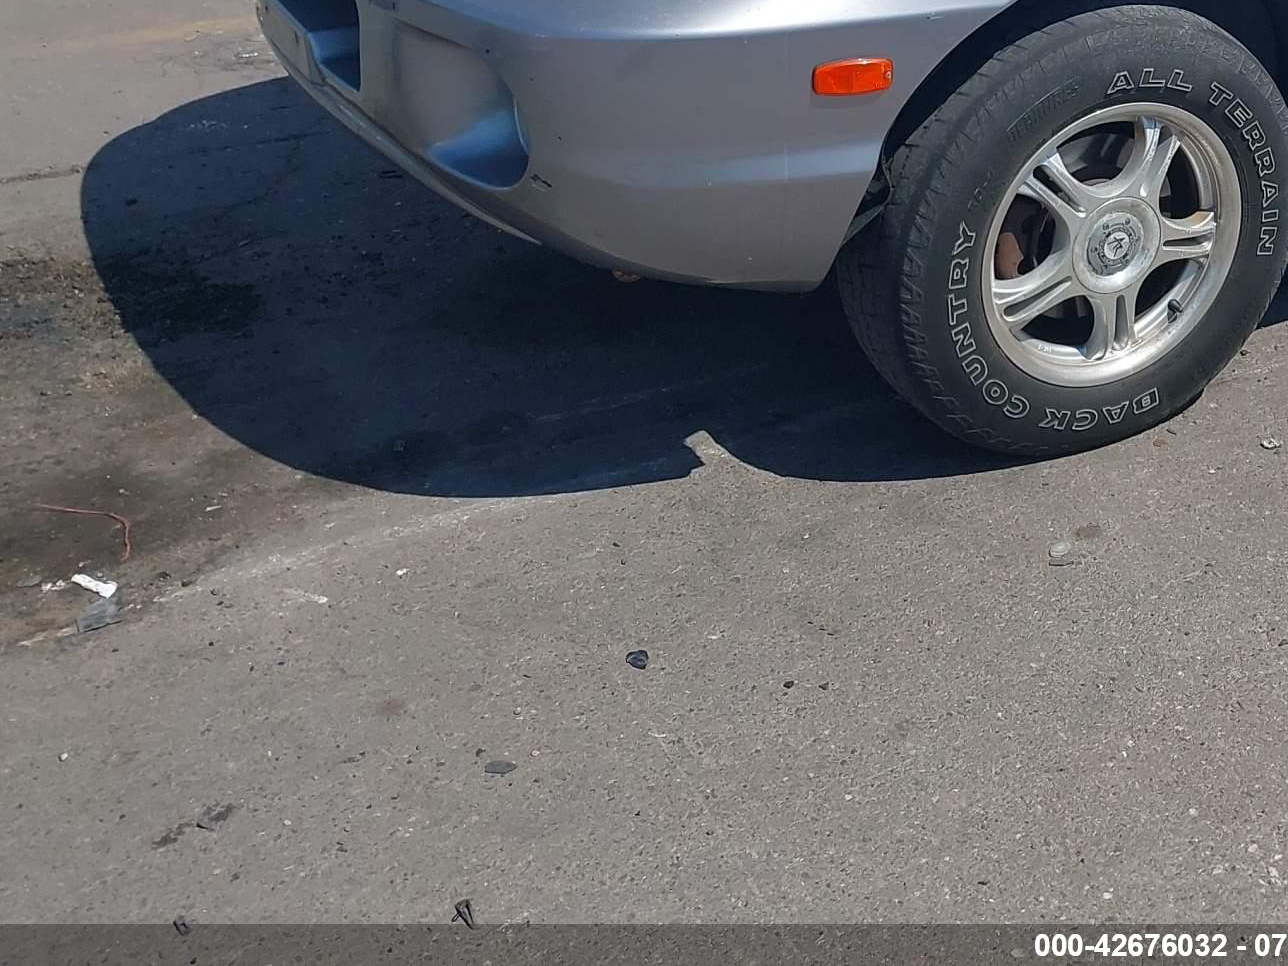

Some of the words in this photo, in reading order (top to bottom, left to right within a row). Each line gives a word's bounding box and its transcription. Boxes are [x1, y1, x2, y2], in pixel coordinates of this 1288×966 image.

[1106, 67, 1193, 97] ALL
[1209, 81, 1280, 257] TERRAIN
[948, 218, 1031, 419] COUNTRY
[1040, 387, 1161, 431] BACK
